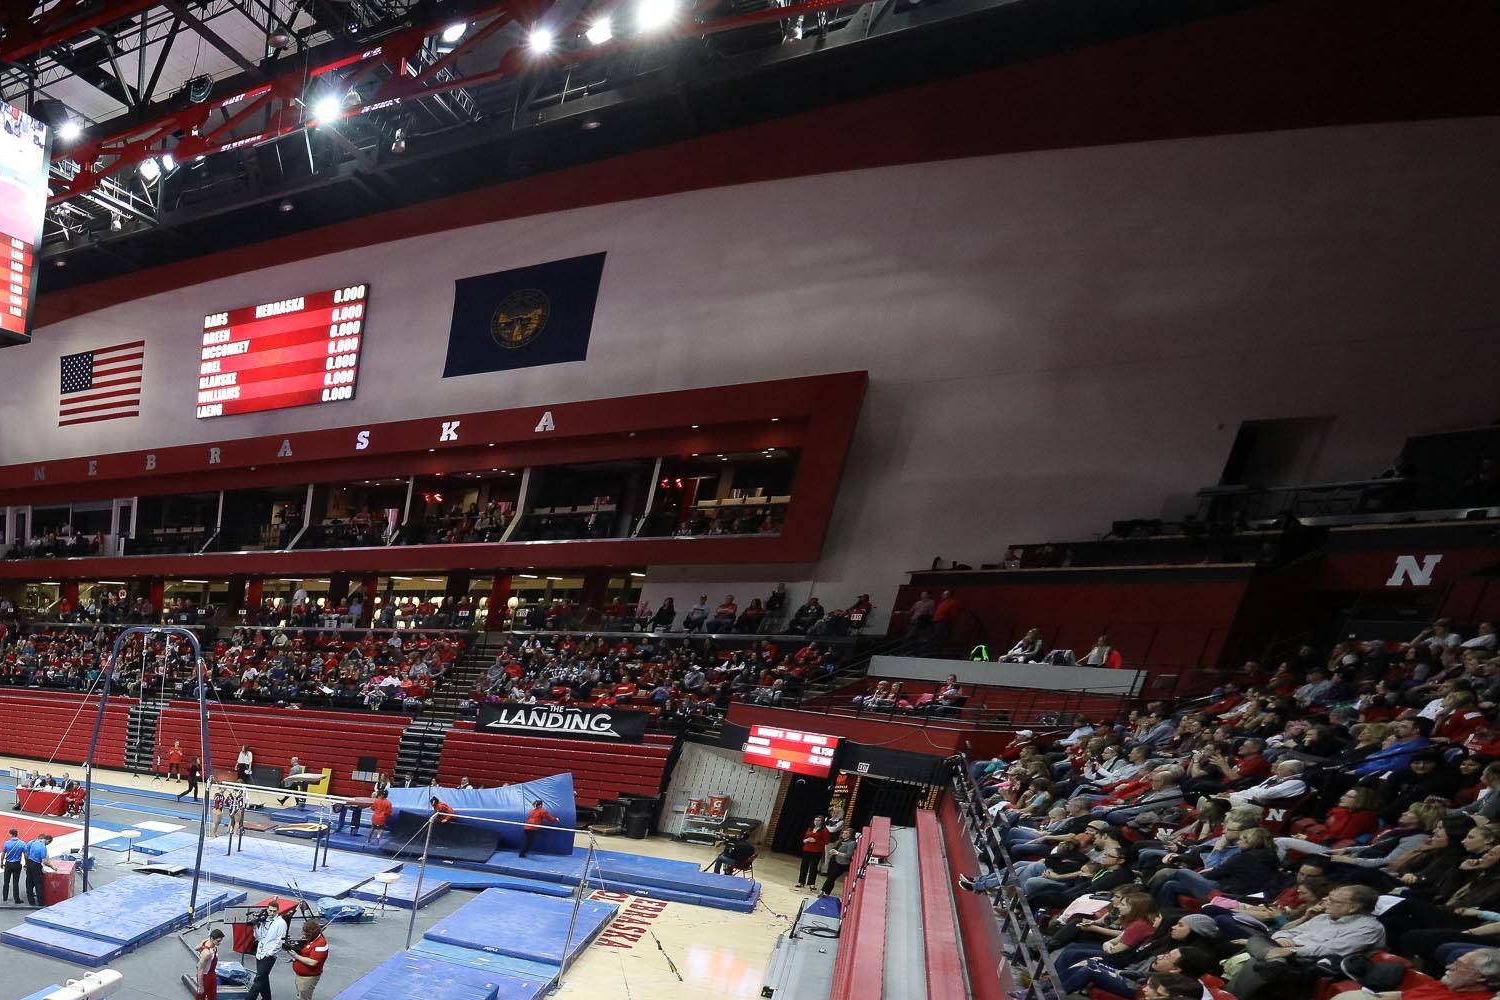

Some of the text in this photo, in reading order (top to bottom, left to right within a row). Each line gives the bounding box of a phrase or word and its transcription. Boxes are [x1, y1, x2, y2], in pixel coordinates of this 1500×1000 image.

[334, 285, 365, 303] 0.000
[255, 297, 305, 318] NEBRASKA
[332, 304, 363, 322] 0.000
[204, 313, 228, 328] BARS
[329, 321, 361, 338] 0.000
[328, 337, 359, 354] 0.000
[326, 353, 356, 370] 0.000
[324, 370, 354, 386] 0.000
[198, 386, 241, 404] WILLIAMS
[322, 386, 352, 401] 0.000
[1385, 554, 1443, 587] N
[550, 705, 564, 713] THE
[498, 709, 612, 731] LANDING
[713, 799, 723, 809] G
[1265, 808, 1287, 821] N
